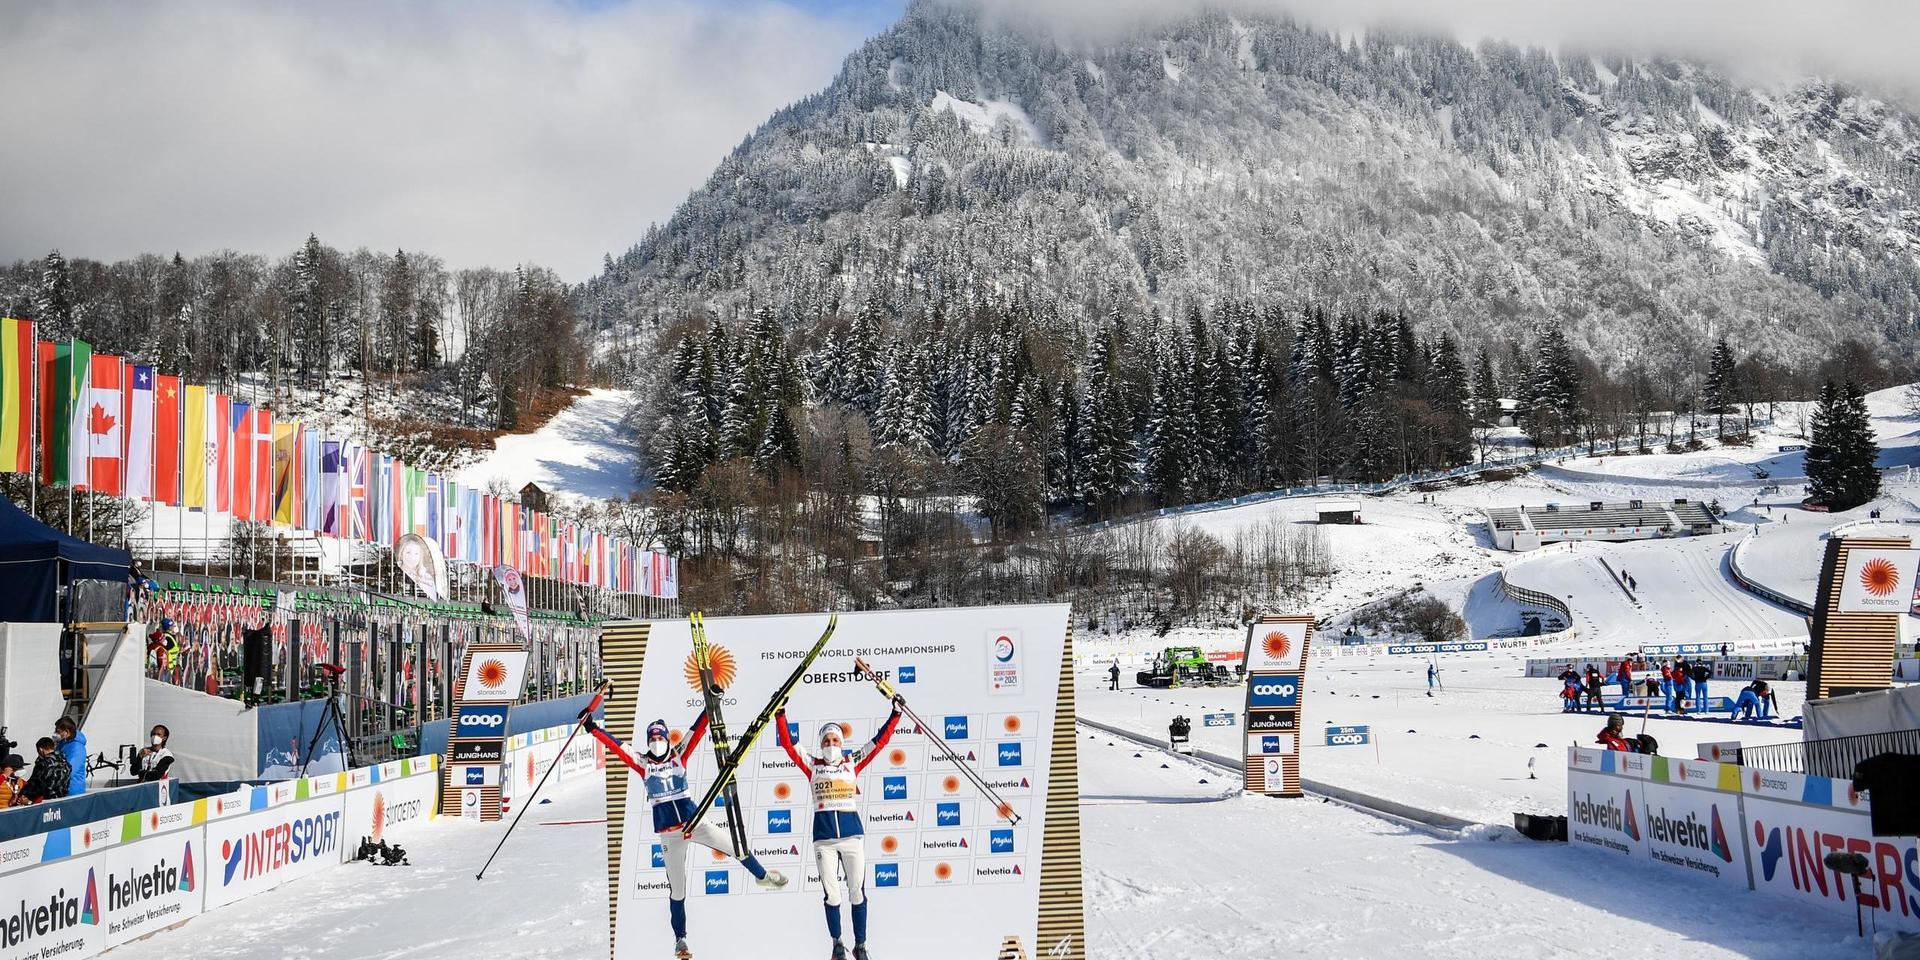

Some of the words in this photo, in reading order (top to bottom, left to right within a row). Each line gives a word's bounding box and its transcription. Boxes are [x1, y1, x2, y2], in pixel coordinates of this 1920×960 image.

[1861, 598, 1899, 606] storaenso
[761, 652, 775, 660] FIS
[778, 651, 810, 660] NORDI
[819, 648, 854, 658] WORLD
[856, 648, 872, 656] SKI
[873, 645, 955, 656] CHAMPIONSHIPS
[1392, 646, 1412, 654] coop
[1414, 645, 1435, 653] coop
[1441, 644, 1462, 652] coop
[1464, 643, 1485, 651] coop
[1644, 646, 1660, 655] coop
[1662, 645, 1679, 654] coop
[1682, 644, 1699, 653] coop
[1701, 643, 1717, 652] coop
[1724, 662, 1753, 678] WÜRTH
[1254, 685, 1294, 697] coop
[460, 714, 503, 728] coop
[1251, 720, 1293, 728] JUNGHANS
[1332, 735, 1363, 745] coop
[455, 751, 499, 759] JUNGHANS
[931, 753, 966, 762] helvetia
[762, 761, 796, 769] helvetia
[661, 778, 674, 792] 11
[815, 781, 833, 790] 2021
[985, 780, 1019, 789] helvetia
[386, 799, 421, 827] storaenso
[1573, 791, 1622, 832] helvetia
[869, 813, 904, 822] helvetia
[1646, 803, 1710, 851] helvetia
[243, 811, 340, 881] INTERSPORT
[923, 840, 958, 849] helvetia
[754, 848, 788, 856] helvetia
[977, 867, 1011, 876] helvetia
[109, 858, 177, 912] helvetia
[637, 882, 671, 890] helvetia
[109, 922, 121, 935] Ihre
[122, 913, 146, 931] Schweizer
[147, 902, 182, 920] Versicherung.
[41, 938, 85, 959] Versicherung.
